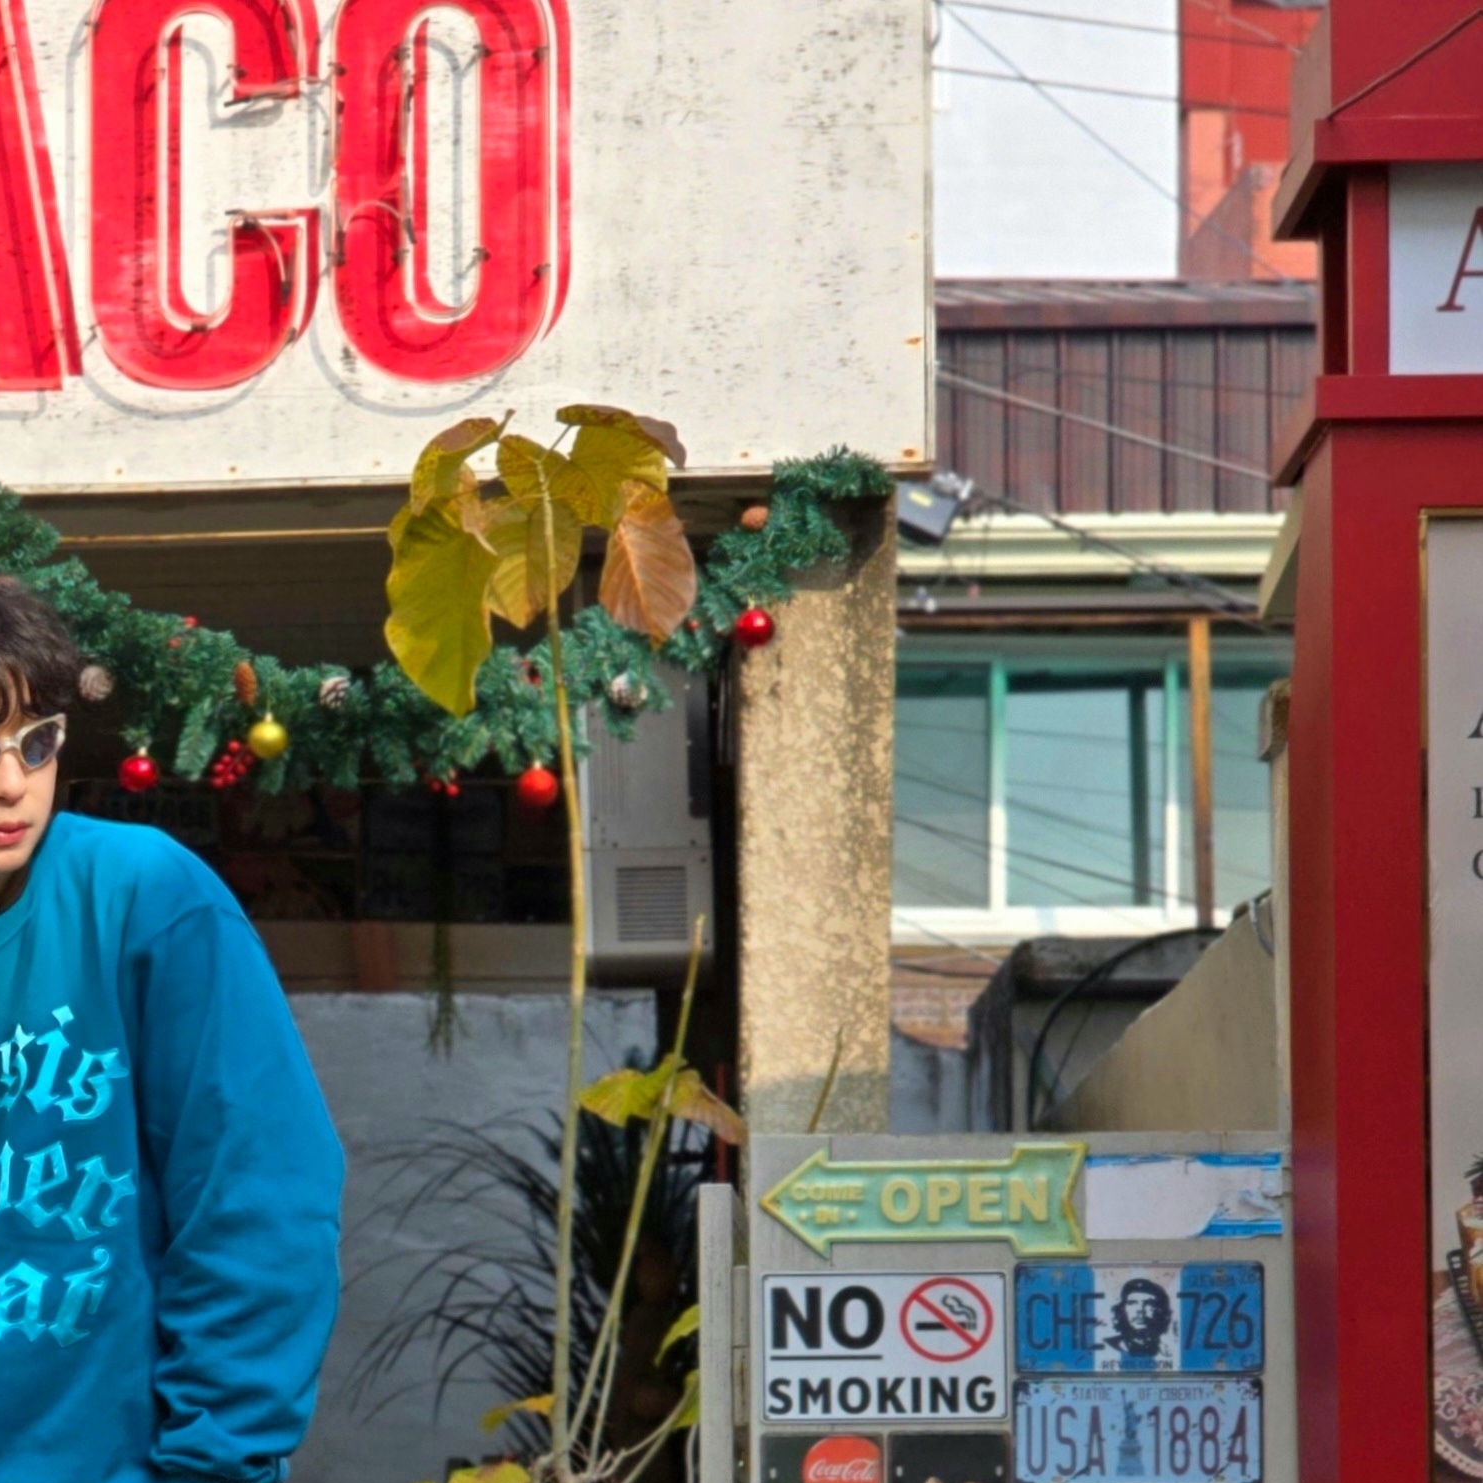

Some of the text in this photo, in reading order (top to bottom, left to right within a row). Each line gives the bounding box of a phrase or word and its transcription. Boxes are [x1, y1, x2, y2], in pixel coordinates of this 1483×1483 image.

[879, 1175, 1050, 1224] OPEN
[770, 1285, 885, 1351] NO
[1025, 1291, 1254, 1351] CHE 726
[767, 1375, 997, 1416] SMOKING
[1025, 1405, 1250, 1477] USA 1884
